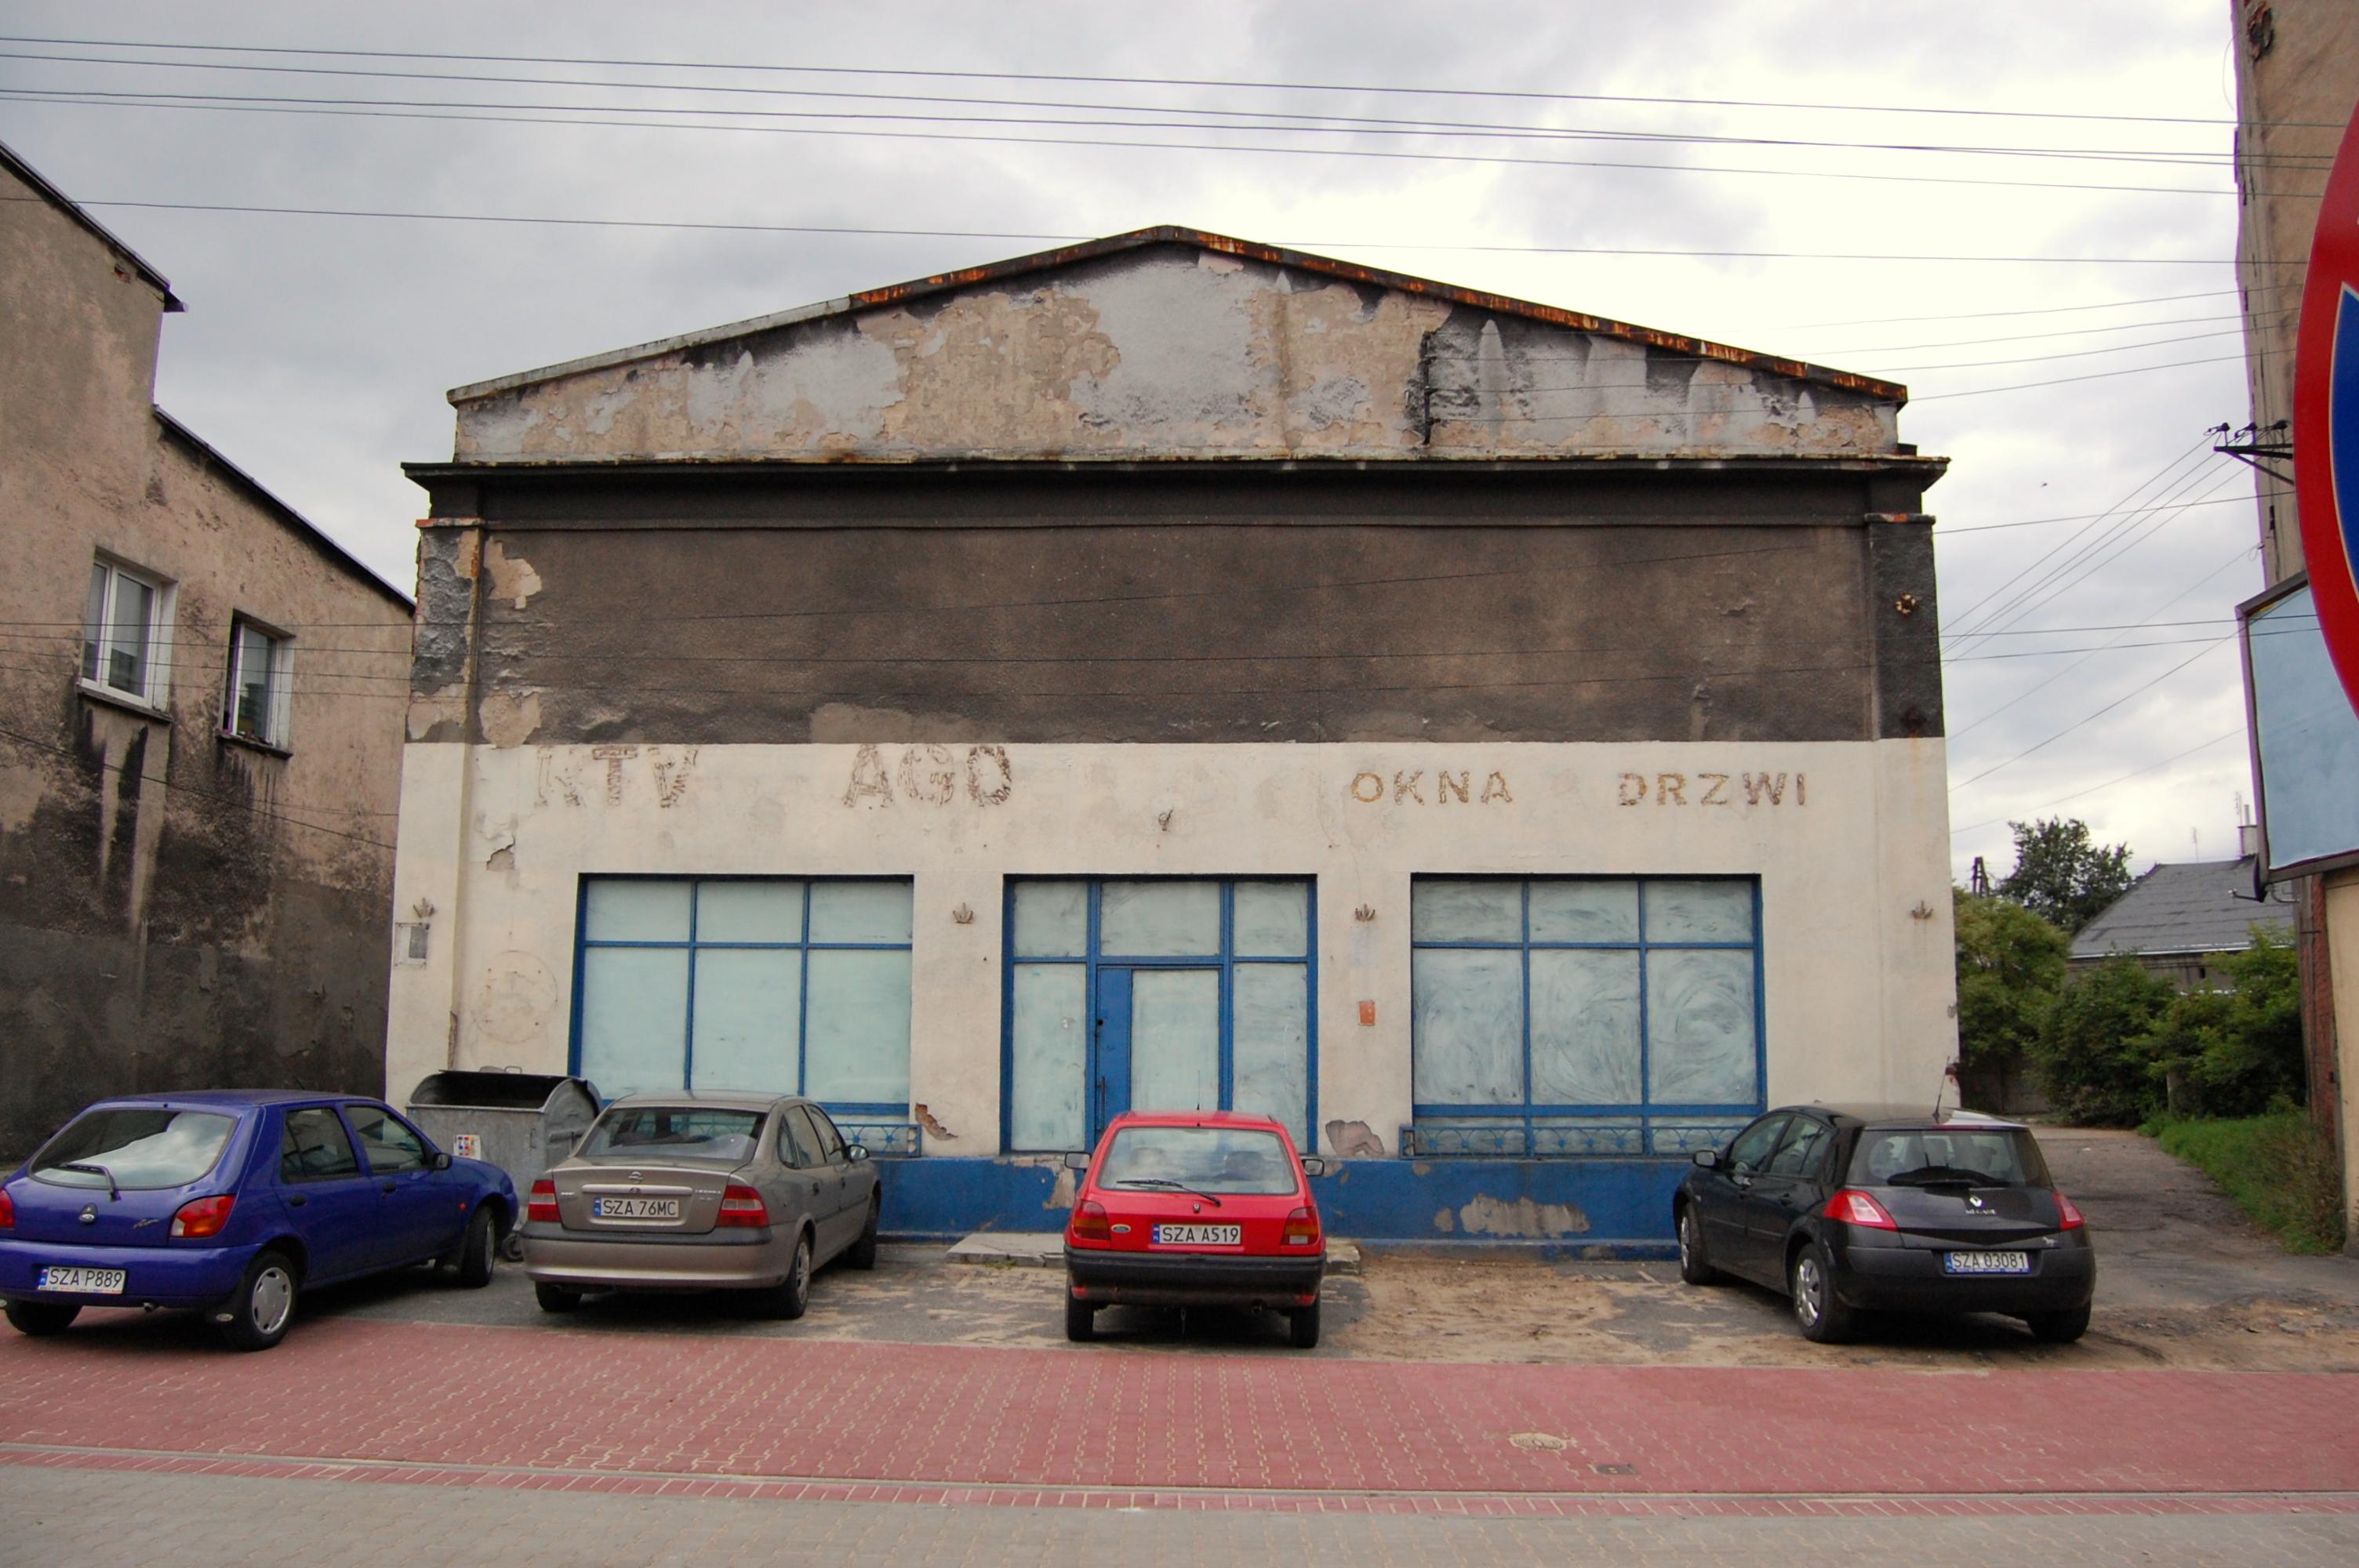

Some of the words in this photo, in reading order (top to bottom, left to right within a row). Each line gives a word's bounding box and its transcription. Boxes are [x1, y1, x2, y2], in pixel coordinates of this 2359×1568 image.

[1350, 771, 1514, 806] OKNA
[1619, 771, 1805, 806] DRZWI
[603, 1199, 634, 1215] SZA
[639, 1201, 677, 1216] 76MC
[1162, 1226, 1195, 1243] SZA
[1201, 1226, 1239, 1243] A519
[1952, 1253, 1981, 1268] SZA
[1984, 1253, 2026, 1269] 03081
[49, 1268, 80, 1286] SZA
[85, 1269, 122, 1288] P889
